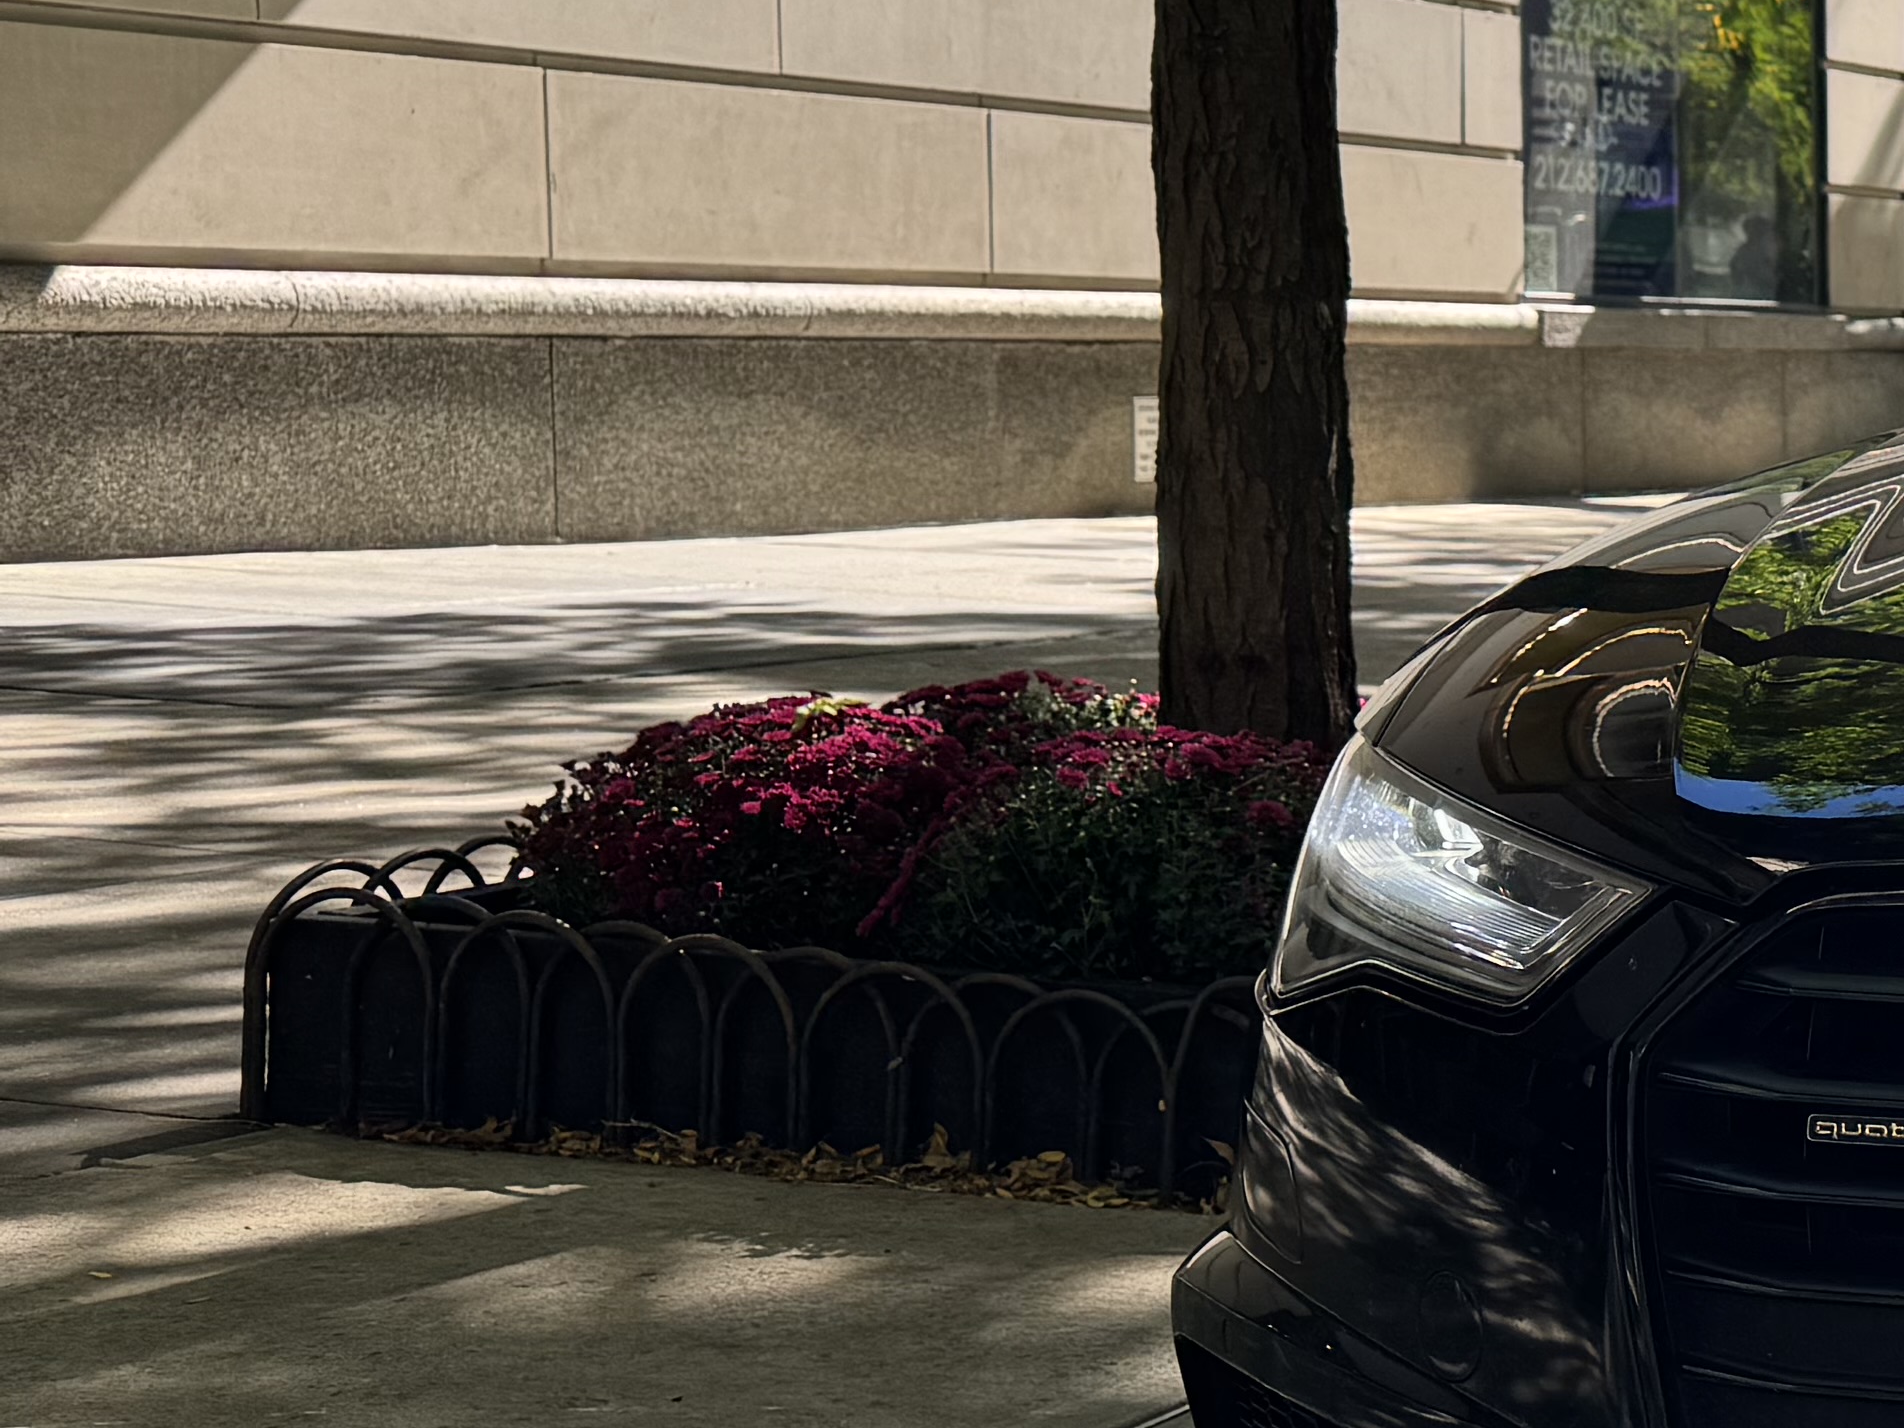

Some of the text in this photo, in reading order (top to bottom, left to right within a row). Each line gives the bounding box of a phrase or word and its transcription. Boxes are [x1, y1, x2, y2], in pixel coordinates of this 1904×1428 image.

[1530, 34, 1663, 87] RETAIL SPACE
[1545, 79, 1588, 118] FOR
